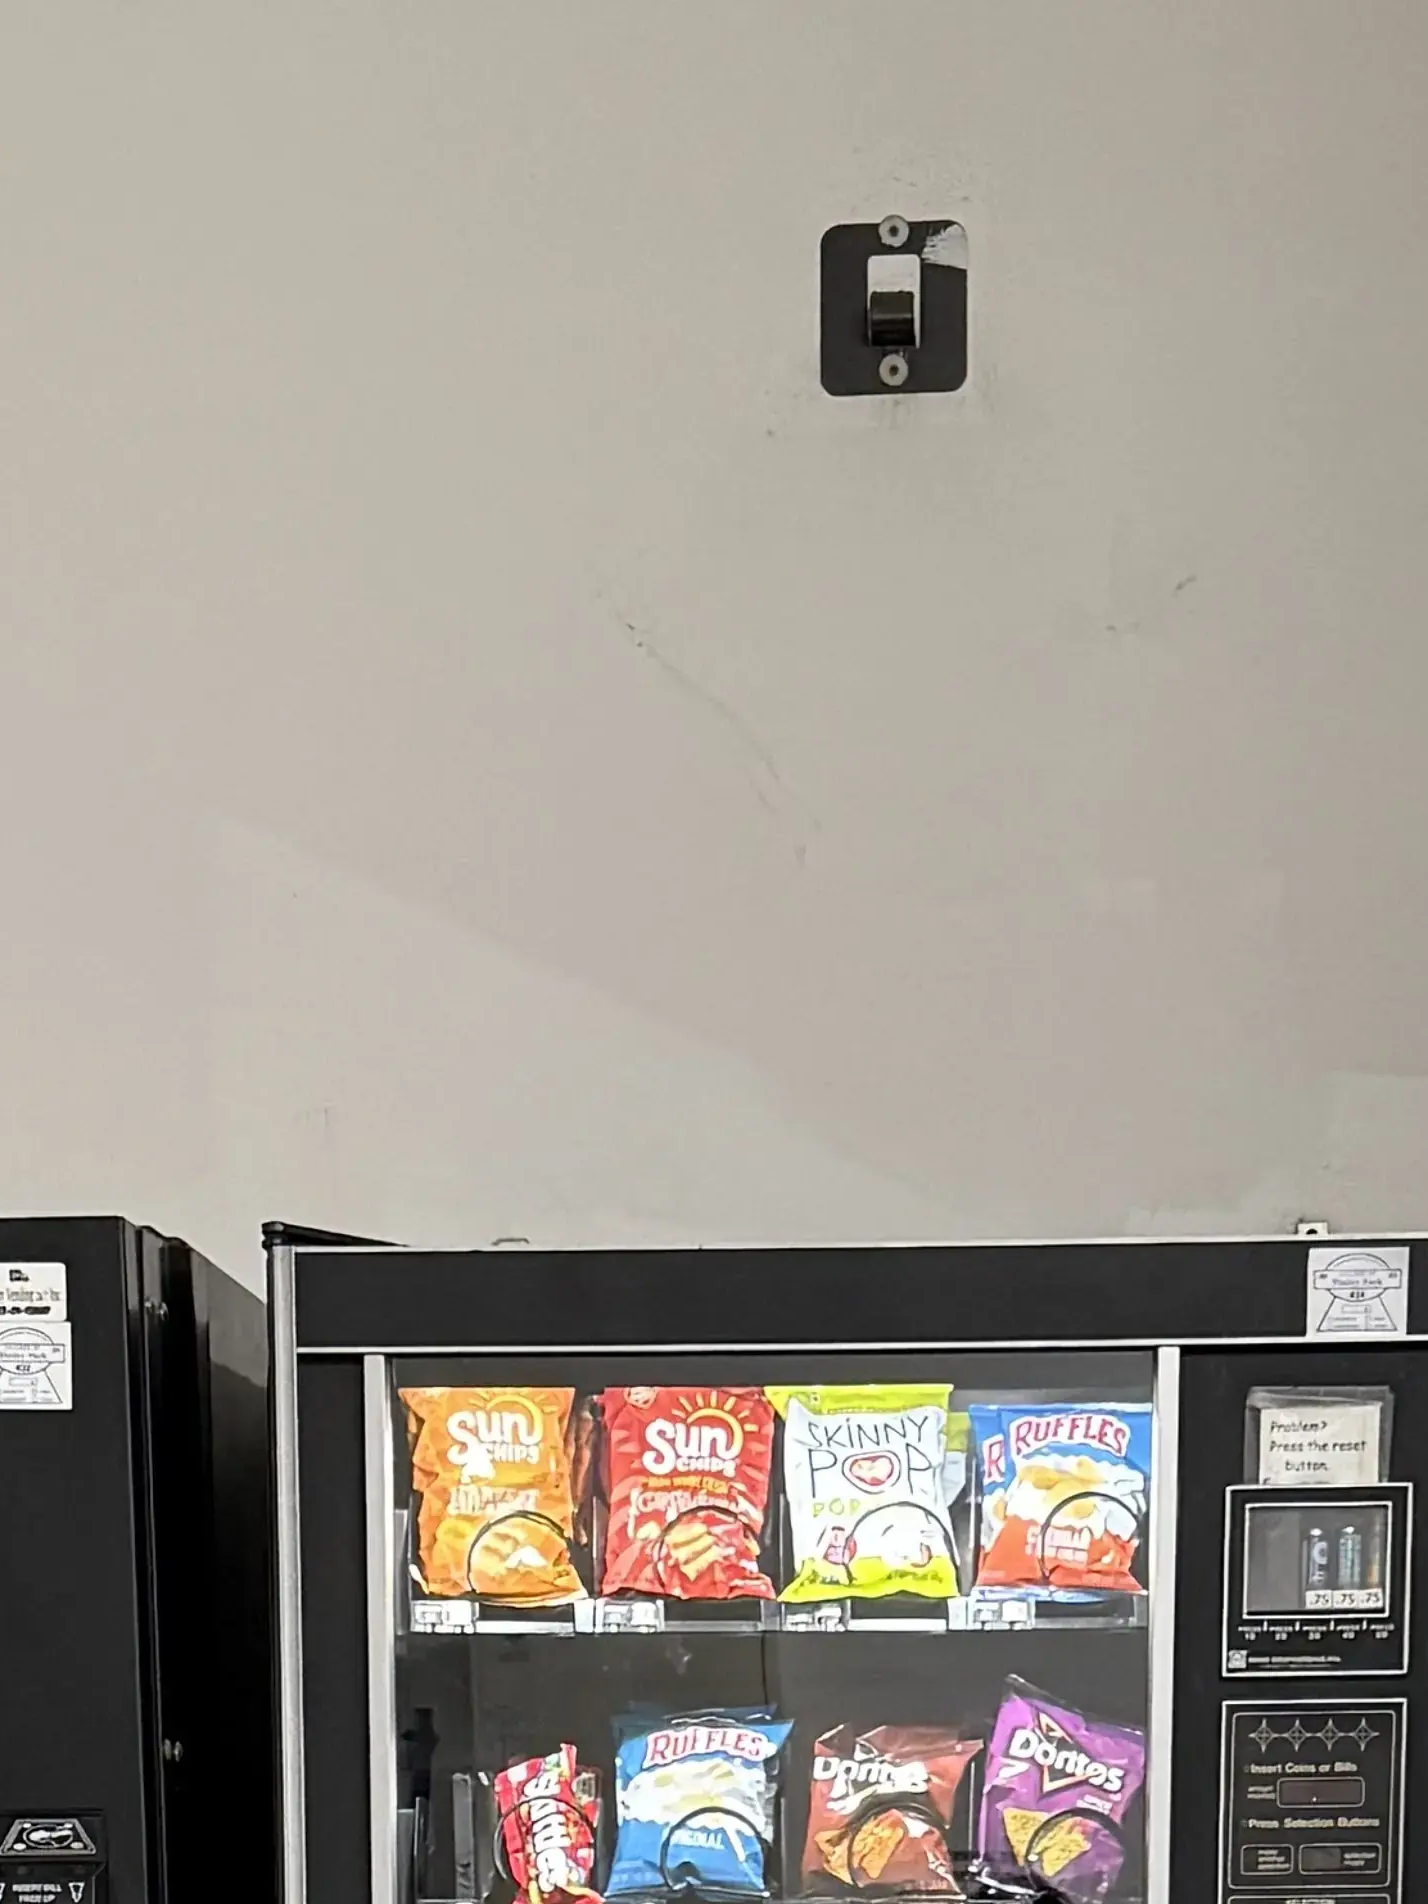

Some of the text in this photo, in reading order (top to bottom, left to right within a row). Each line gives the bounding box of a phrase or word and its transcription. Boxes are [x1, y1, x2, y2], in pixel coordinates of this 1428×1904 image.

[447, 1402, 543, 1465] Sun
[642, 1414, 744, 1475] Sun
[808, 1415, 929, 1449] SKINNY
[1014, 1413, 1127, 1457] RUFFLES
[1269, 1439, 1367, 1452] Press the reset
[808, 1446, 933, 1498] POP
[650, 1729, 765, 1762] RUFFLES
[1009, 1728, 1125, 1792] Doritos
[813, 1755, 928, 1794] Doritos
[1250, 1763, 1282, 1774] Insert
[1285, 1762, 1316, 1773] Coins
[1318, 1764, 1331, 1773] or
[1248, 1819, 1280, 1828] Press
[1284, 1817, 1334, 1828] Selection
